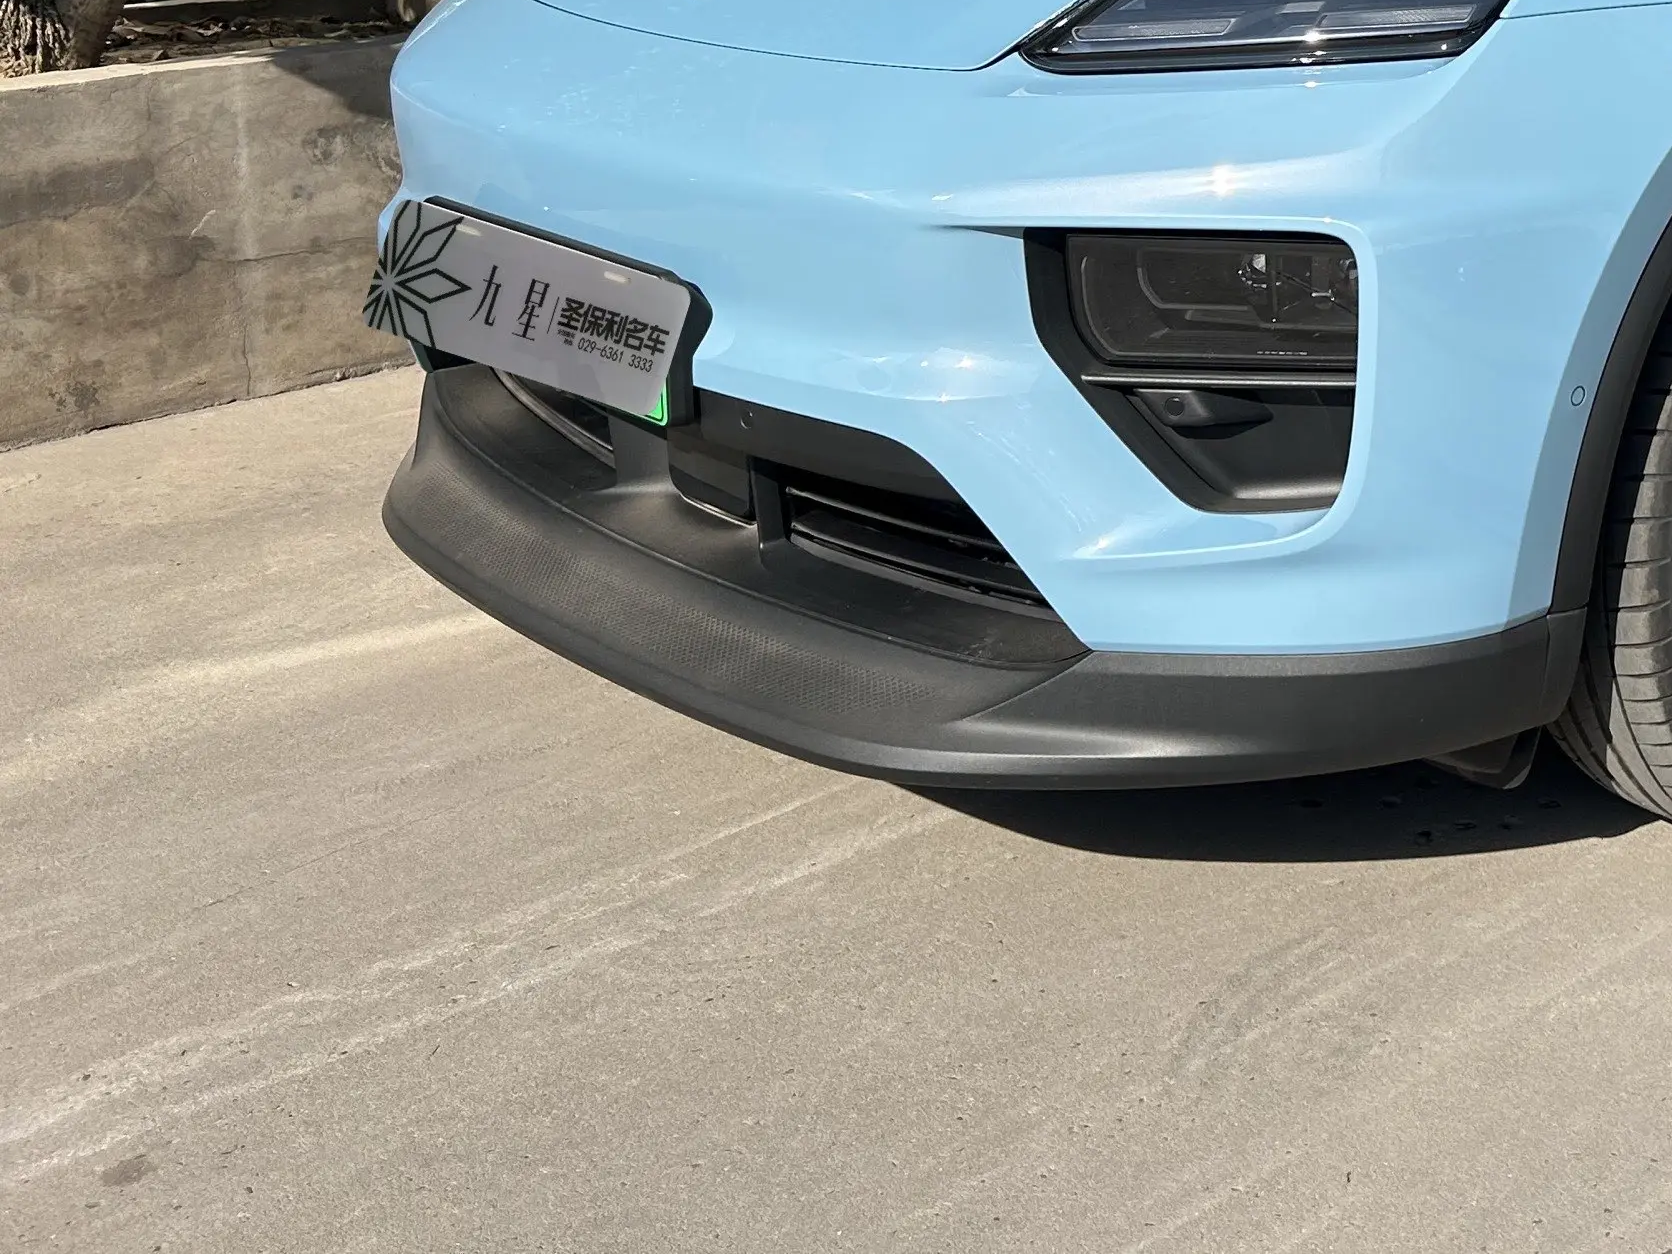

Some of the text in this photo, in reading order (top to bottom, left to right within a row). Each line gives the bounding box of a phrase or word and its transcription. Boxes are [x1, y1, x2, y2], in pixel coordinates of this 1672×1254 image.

[468, 264, 670, 356] 九星 圣保利名车
[577, 337, 624, 363] 029-6361
[628, 354, 654, 373] 3333
